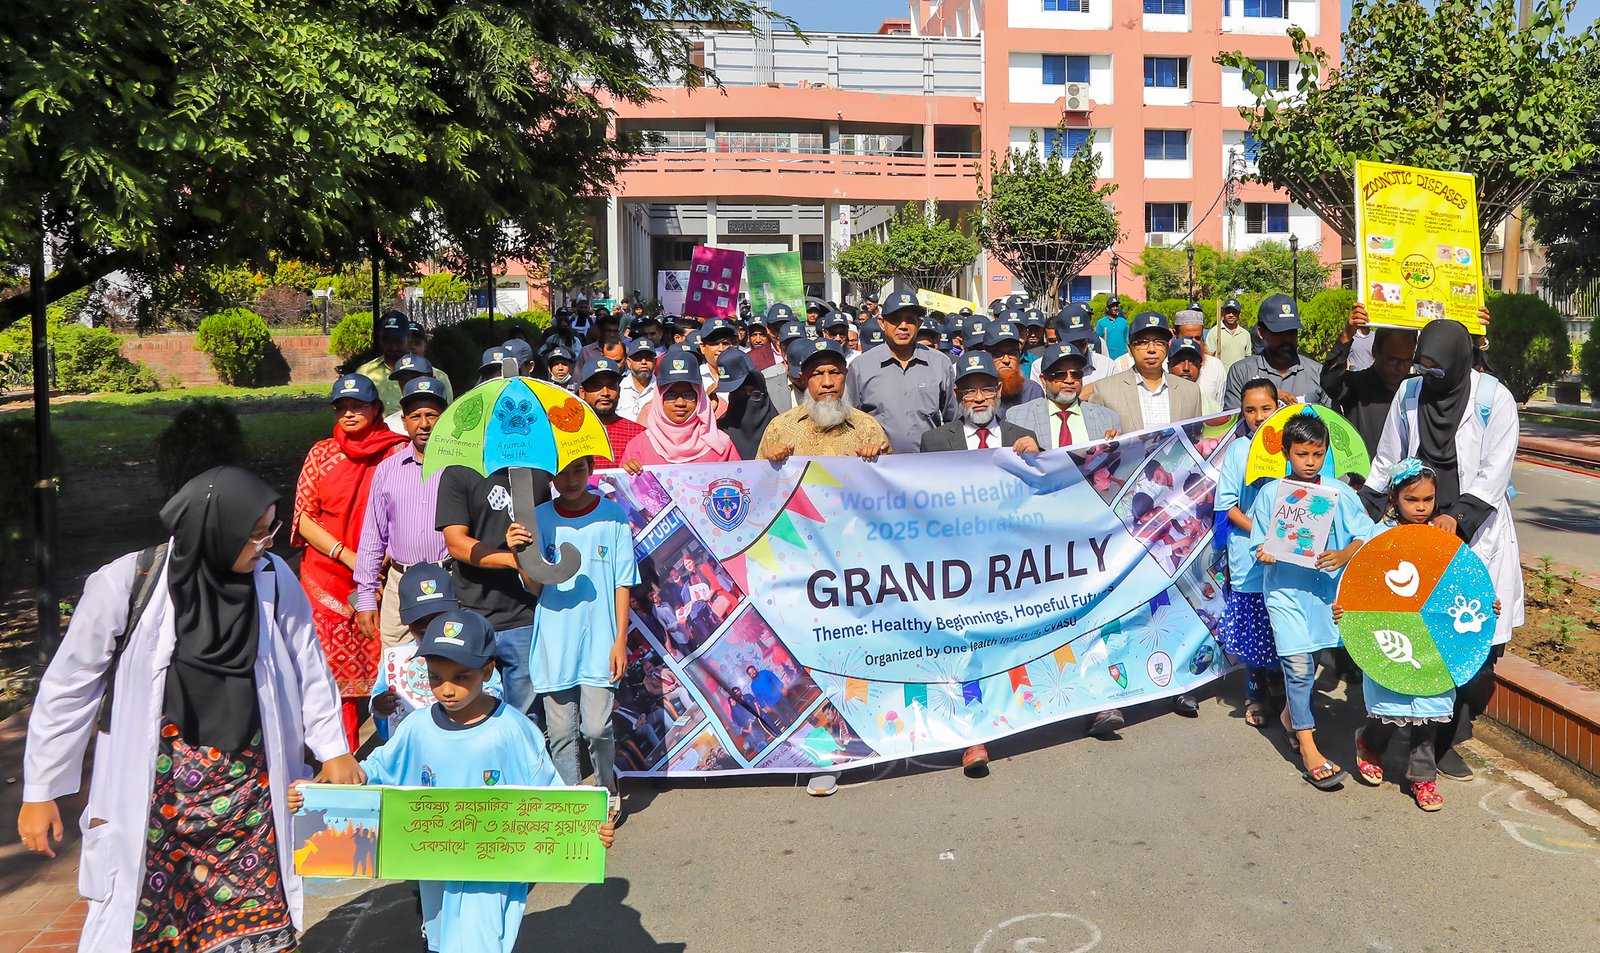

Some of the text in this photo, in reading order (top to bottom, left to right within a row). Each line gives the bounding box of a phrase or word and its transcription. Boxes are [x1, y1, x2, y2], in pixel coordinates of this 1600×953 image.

[1363, 171, 1468, 210] ZOONOTIC DISEASES
[434, 434, 481, 449] Environment
[496, 440, 532, 451] Animal
[560, 434, 596, 449] Human
[567, 443, 595, 457] Health
[437, 446, 467, 458] Health
[501, 450, 529, 459] Health
[1255, 454, 1280, 467] Human
[1253, 463, 1278, 472] Health
[839, 489, 906, 512] World
[912, 489, 957, 512] One
[961, 477, 1024, 506] Health
[1274, 504, 1307, 524] AMR
[866, 508, 1045, 542] 2025 Celebration
[806, 533, 1114, 610] GRAND RALLY
[812, 622, 869, 643] Theme:
[872, 617, 933, 635] Healthy
[936, 608, 1014, 633] Beginnings,
[1013, 594, 1070, 621] Hopeful
[865, 648, 924, 667] Organized
[925, 645, 941, 659] by
[943, 643, 968, 656] One
[1044, 615, 1078, 633] CVASU
[454, 796, 513, 813] মহামারির
[516, 797, 543, 817] ঝুঁকি
[544, 801, 590, 815] কমাতে
[448, 813, 483, 833] প্রাণী
[483, 819, 499, 833] ও
[501, 819, 553, 836] মানুষের
[410, 838, 470, 856] একসাথে
[533, 836, 561, 856] করি
[565, 841, 590, 861] !!!!
